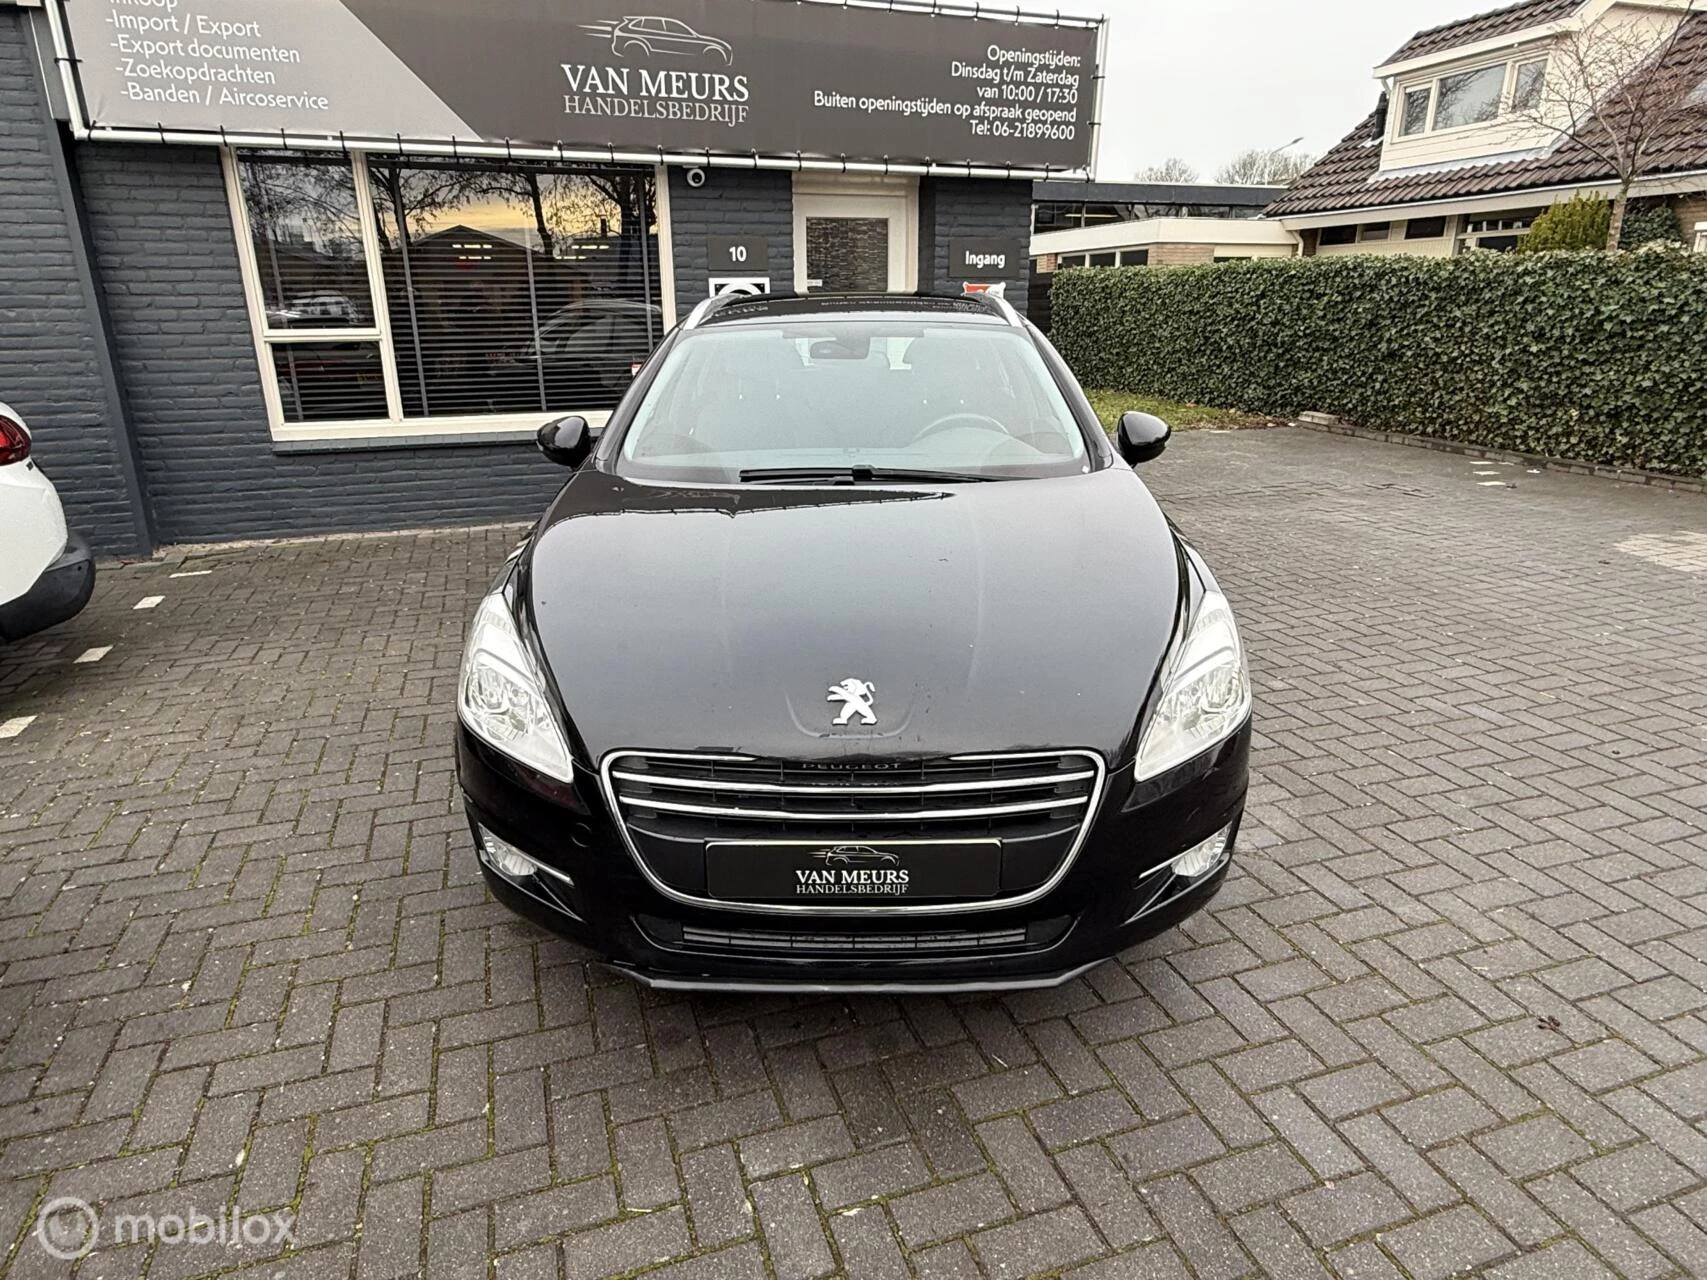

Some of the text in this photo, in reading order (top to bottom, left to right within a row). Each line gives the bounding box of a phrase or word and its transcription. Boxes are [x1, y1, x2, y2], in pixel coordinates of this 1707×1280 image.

[105, 9, 261, 40] -Import / Export
[110, 34, 301, 63] -Export documenten
[987, 44, 1081, 69] Openingstijden:
[115, 58, 276, 84] -Zoekopdrachten
[561, 64, 749, 102] VAN MEURS
[951, 61, 1079, 89] Dinsdag t/m Zaterdag
[120, 82, 329, 110] -Banden / Aircoservice
[977, 85, 1078, 104] van 10:00 / 17:30
[563, 95, 750, 127] HANDELSBEDRIJF
[814, 90, 1077, 126] Buiten openingstijden op afspraak geopend
[969, 119, 1075, 141] Tel: 06-21899600
[729, 246, 747, 262] 10
[965, 250, 1006, 269] Ingang
[802, 762, 901, 770] PEUGEOT
[796, 869, 910, 884] VAN MEURS
[796, 884, 909, 896] HANDELSBEDRIJF
